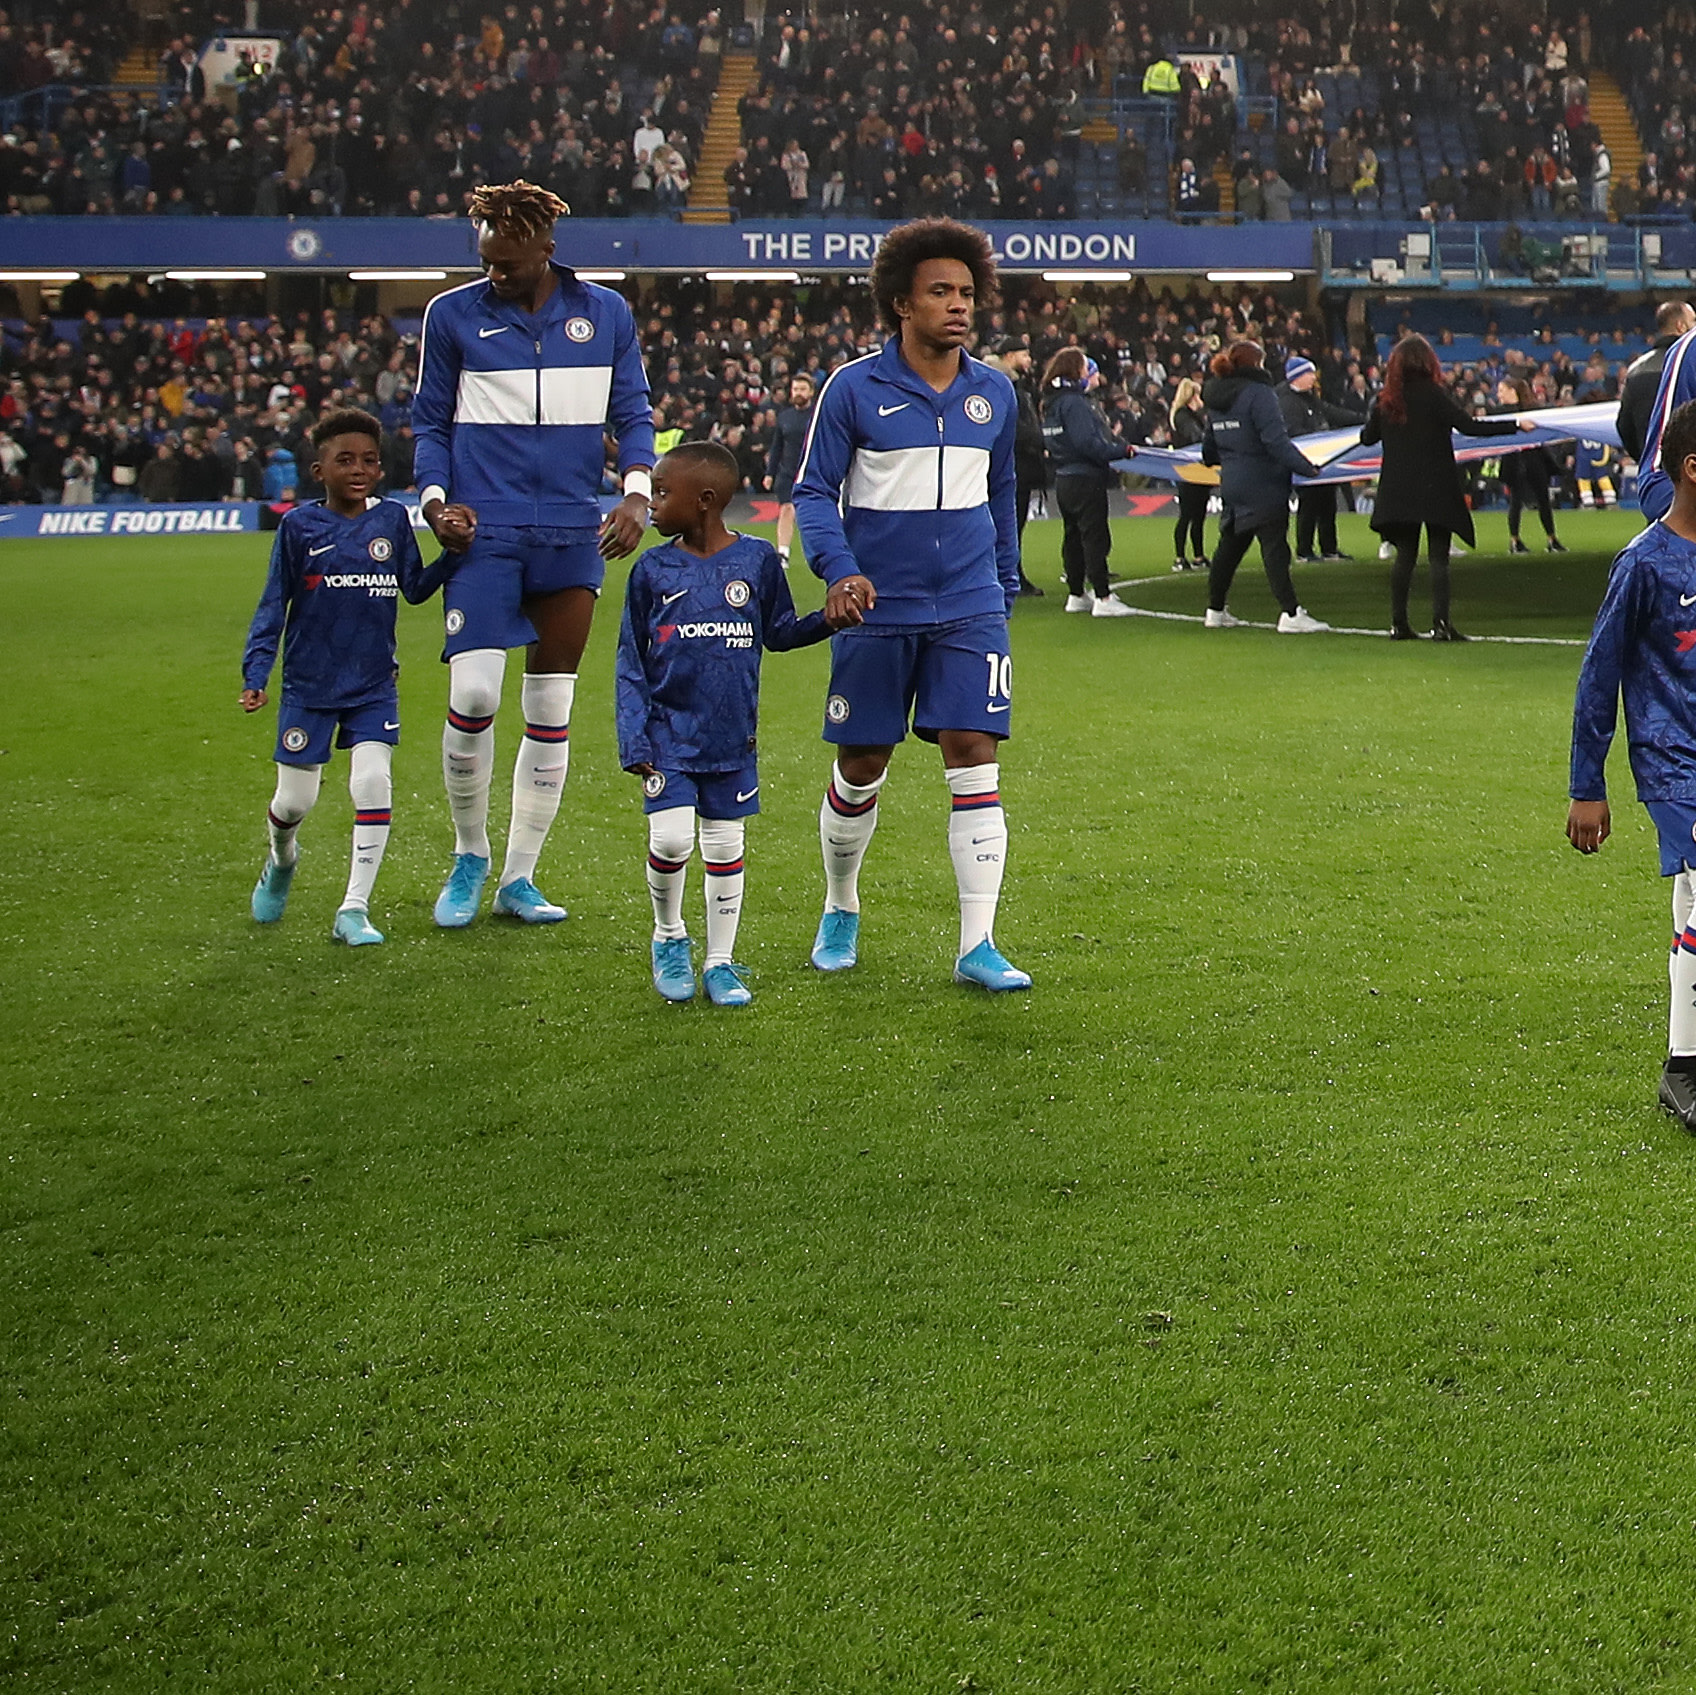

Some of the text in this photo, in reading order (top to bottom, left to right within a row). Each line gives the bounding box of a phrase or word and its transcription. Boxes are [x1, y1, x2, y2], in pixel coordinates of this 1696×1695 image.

[742, 233, 1137, 261] THE PRI LONDON
[39, 509, 243, 535] NIKE FOOTBALL
[323, 574, 398, 588] YOKOHAMA
[368, 587, 397, 597] TYRES
[676, 622, 753, 638] YOKOHAMA
[725, 638, 753, 649] TYRES
[986, 653, 1013, 700] 10
[534, 779, 557, 788] CFC
[357, 856, 374, 864] CFC
[976, 854, 999, 863] CFC
[719, 907, 737, 915] CFC
